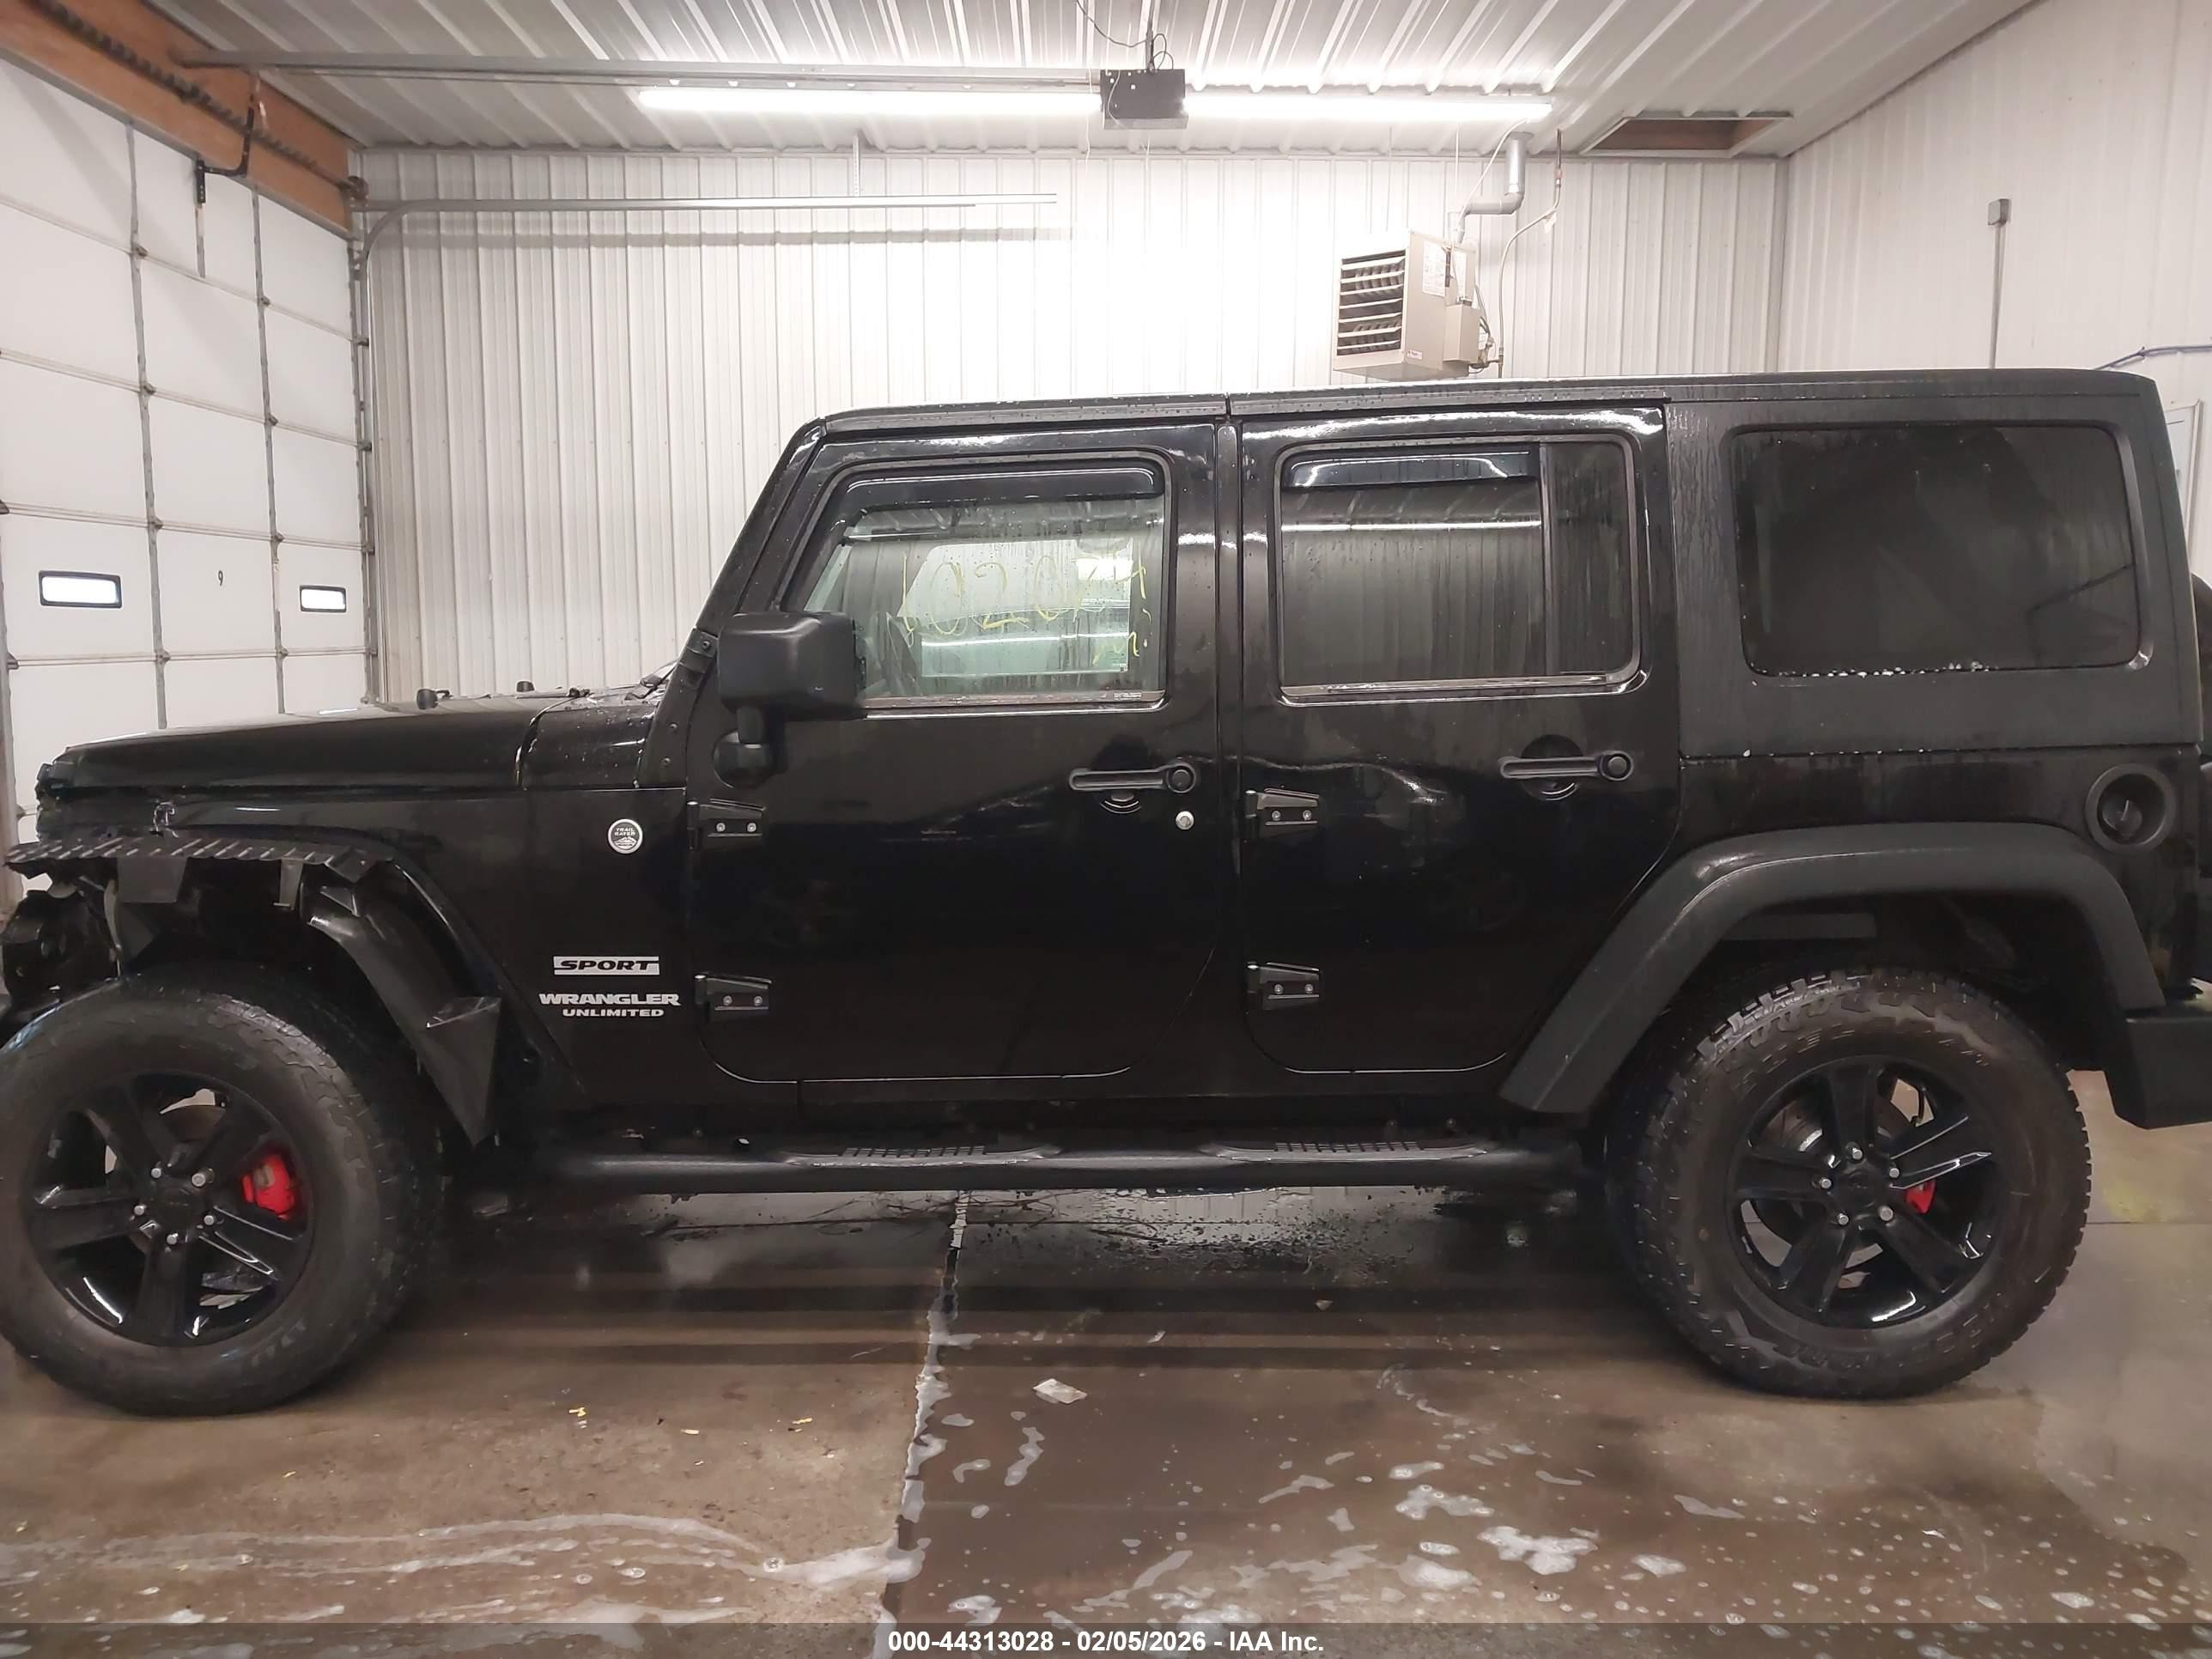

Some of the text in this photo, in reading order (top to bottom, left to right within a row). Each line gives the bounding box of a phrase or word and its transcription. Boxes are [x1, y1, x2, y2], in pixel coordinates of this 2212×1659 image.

[218, 569, 223, 586] 9
[554, 958, 659, 972] SPORT
[538, 993, 681, 1006] WRANGLER
[562, 1008, 665, 1017] UNLIMITED
